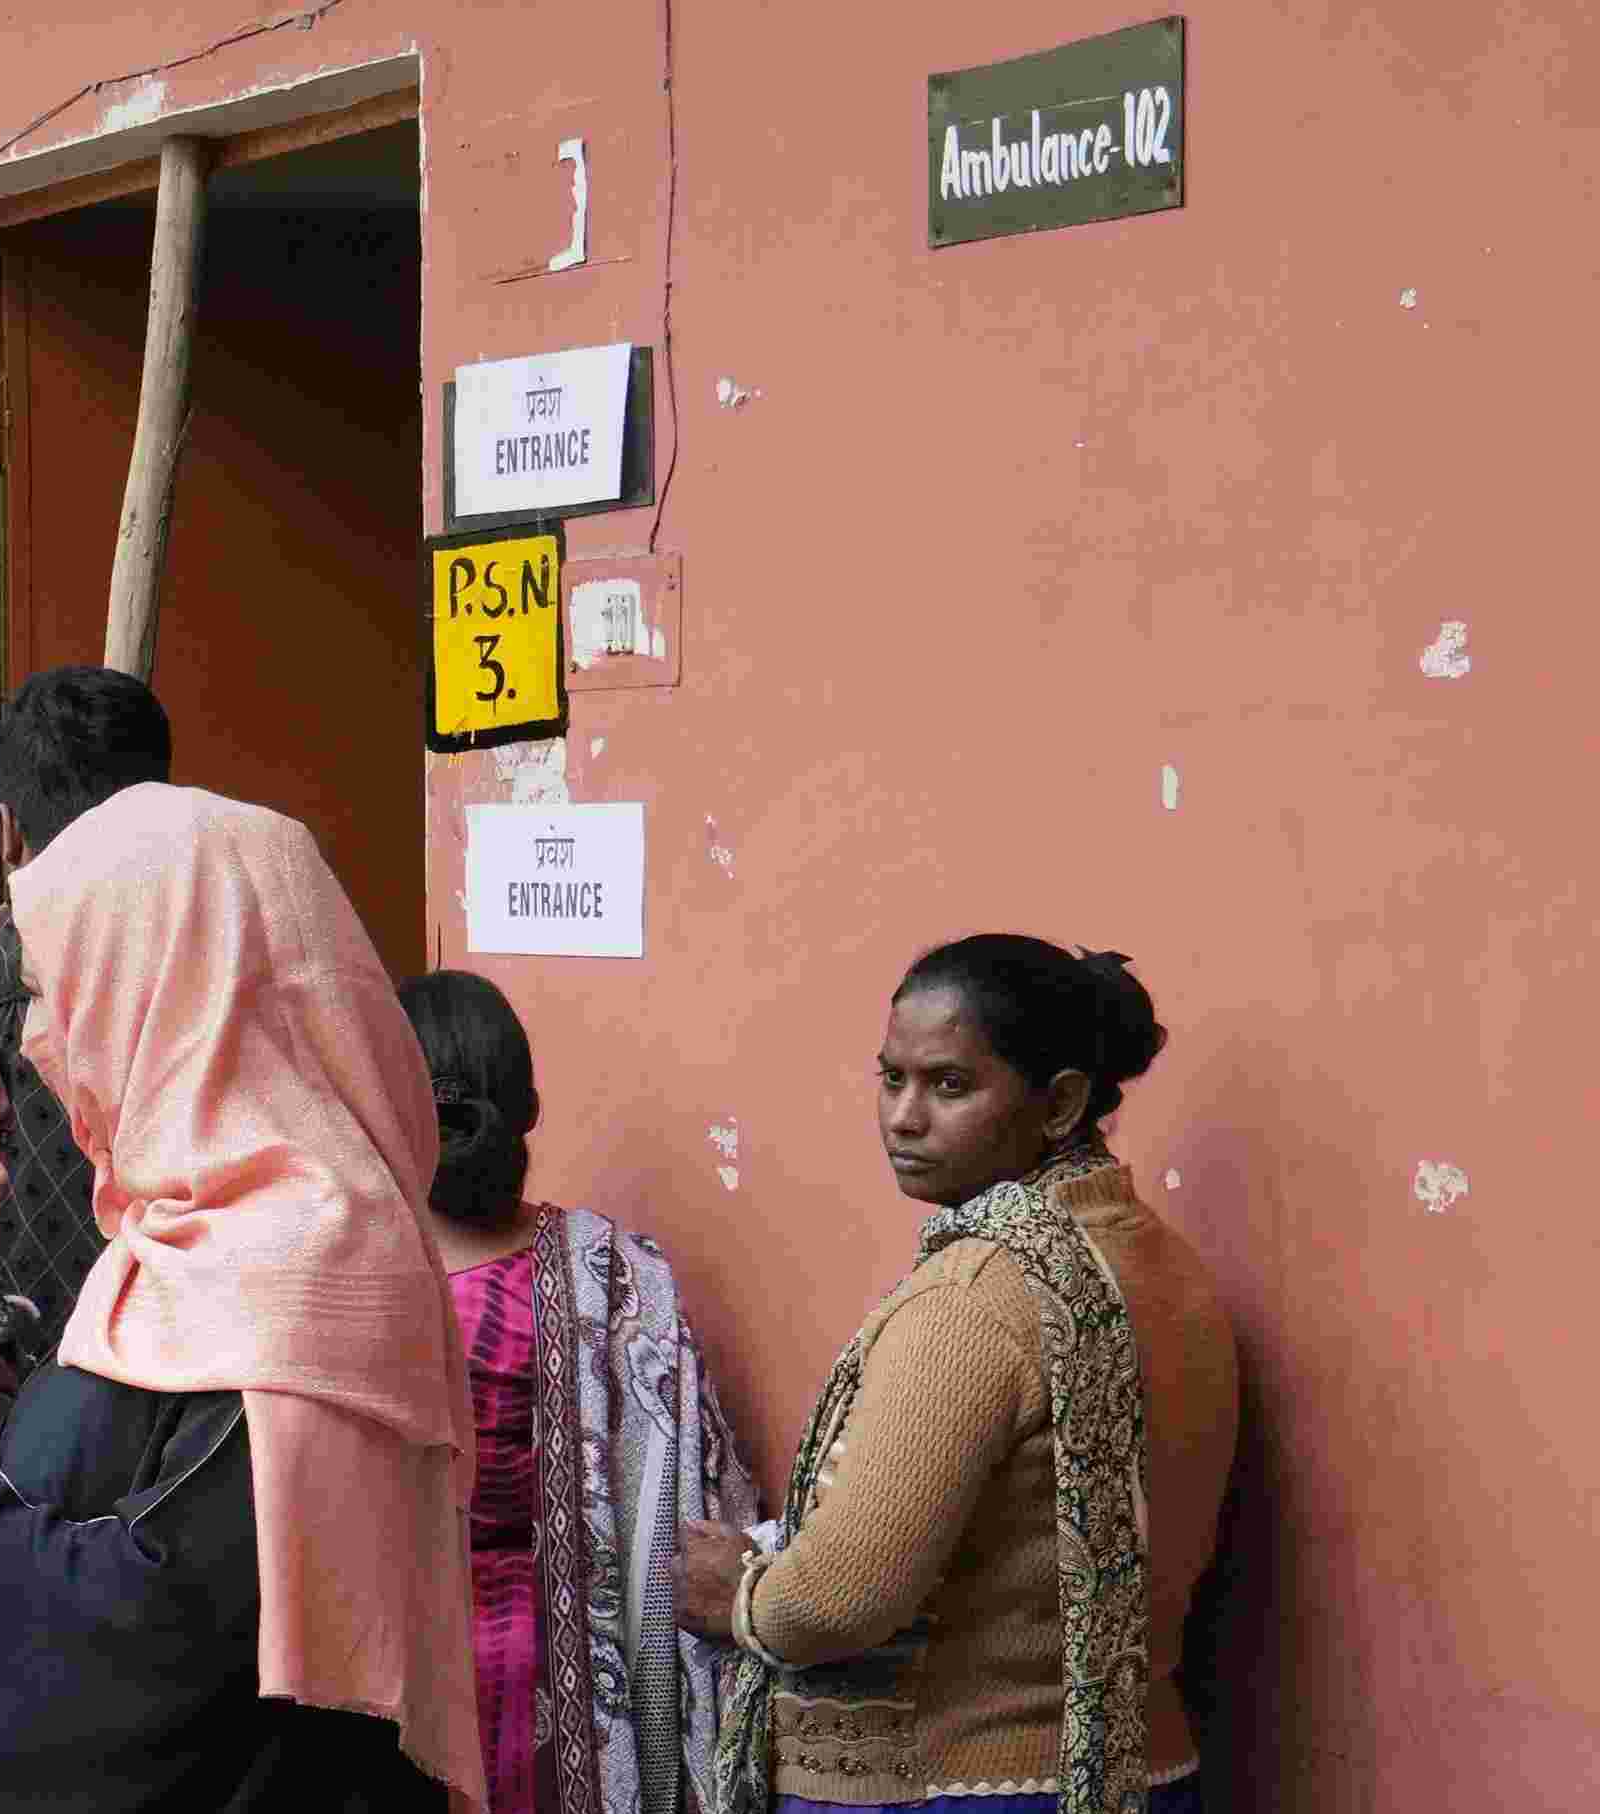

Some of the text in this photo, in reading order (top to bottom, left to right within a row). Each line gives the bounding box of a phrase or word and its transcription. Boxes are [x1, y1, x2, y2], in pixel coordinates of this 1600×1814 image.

[940, 86, 1171, 200] Ambulance-102
[495, 428, 591, 476] ENTRANCE
[507, 881, 604, 920] ENTRANCE
